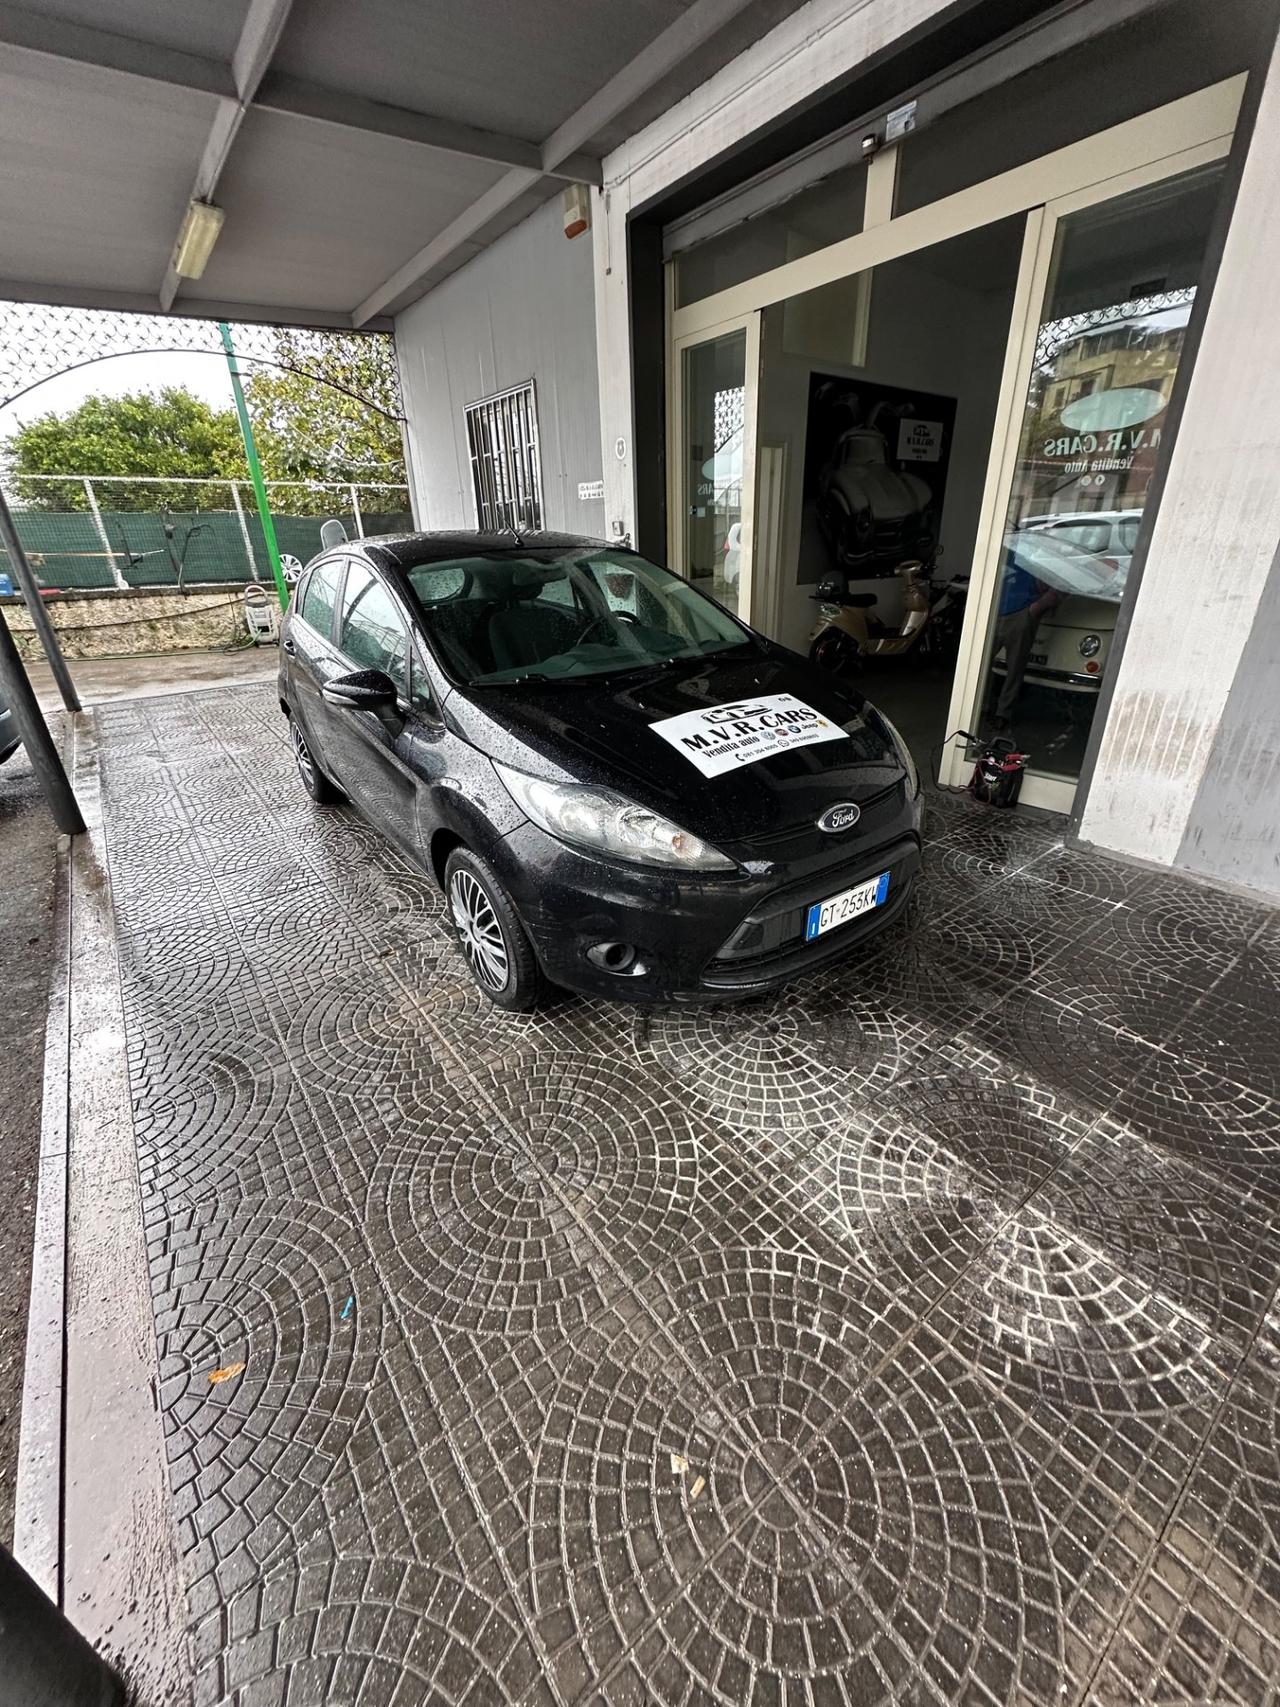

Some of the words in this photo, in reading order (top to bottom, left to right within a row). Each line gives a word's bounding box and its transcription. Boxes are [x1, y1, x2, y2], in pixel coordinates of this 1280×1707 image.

[702, 741, 740, 758] Vendita
[739, 736, 760, 748] auto
[832, 808, 854, 828] Ford
